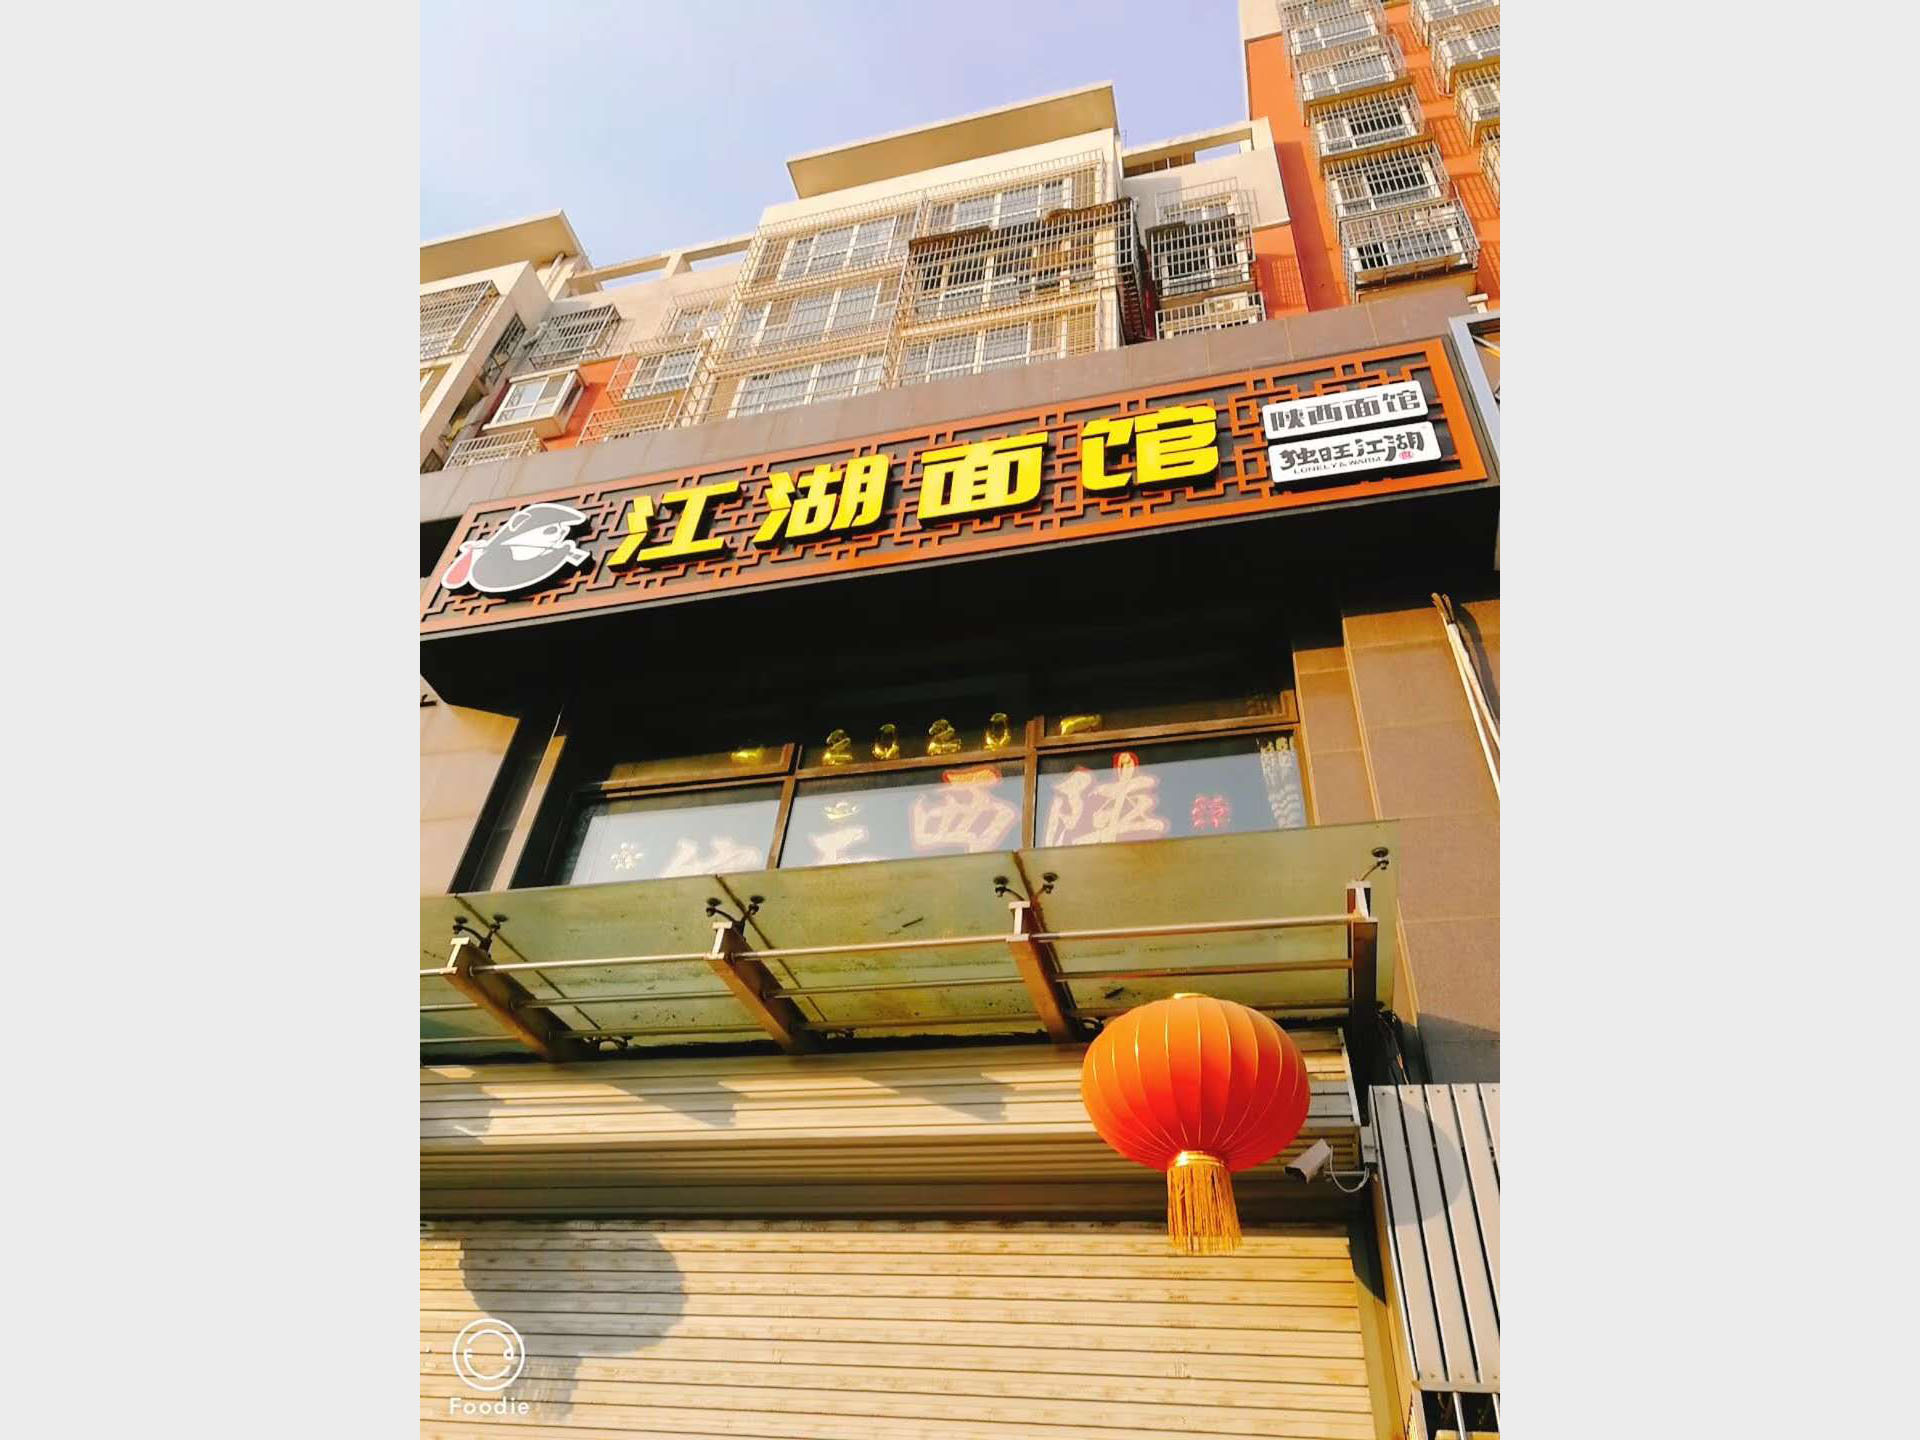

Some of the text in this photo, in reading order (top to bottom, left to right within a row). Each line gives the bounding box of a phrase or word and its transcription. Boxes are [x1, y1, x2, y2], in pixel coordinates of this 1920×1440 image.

[1270, 389, 1421, 432] 陕西面馆
[1279, 431, 1425, 471] 独旺江湖
[607, 405, 1220, 568] 江湖面馆
